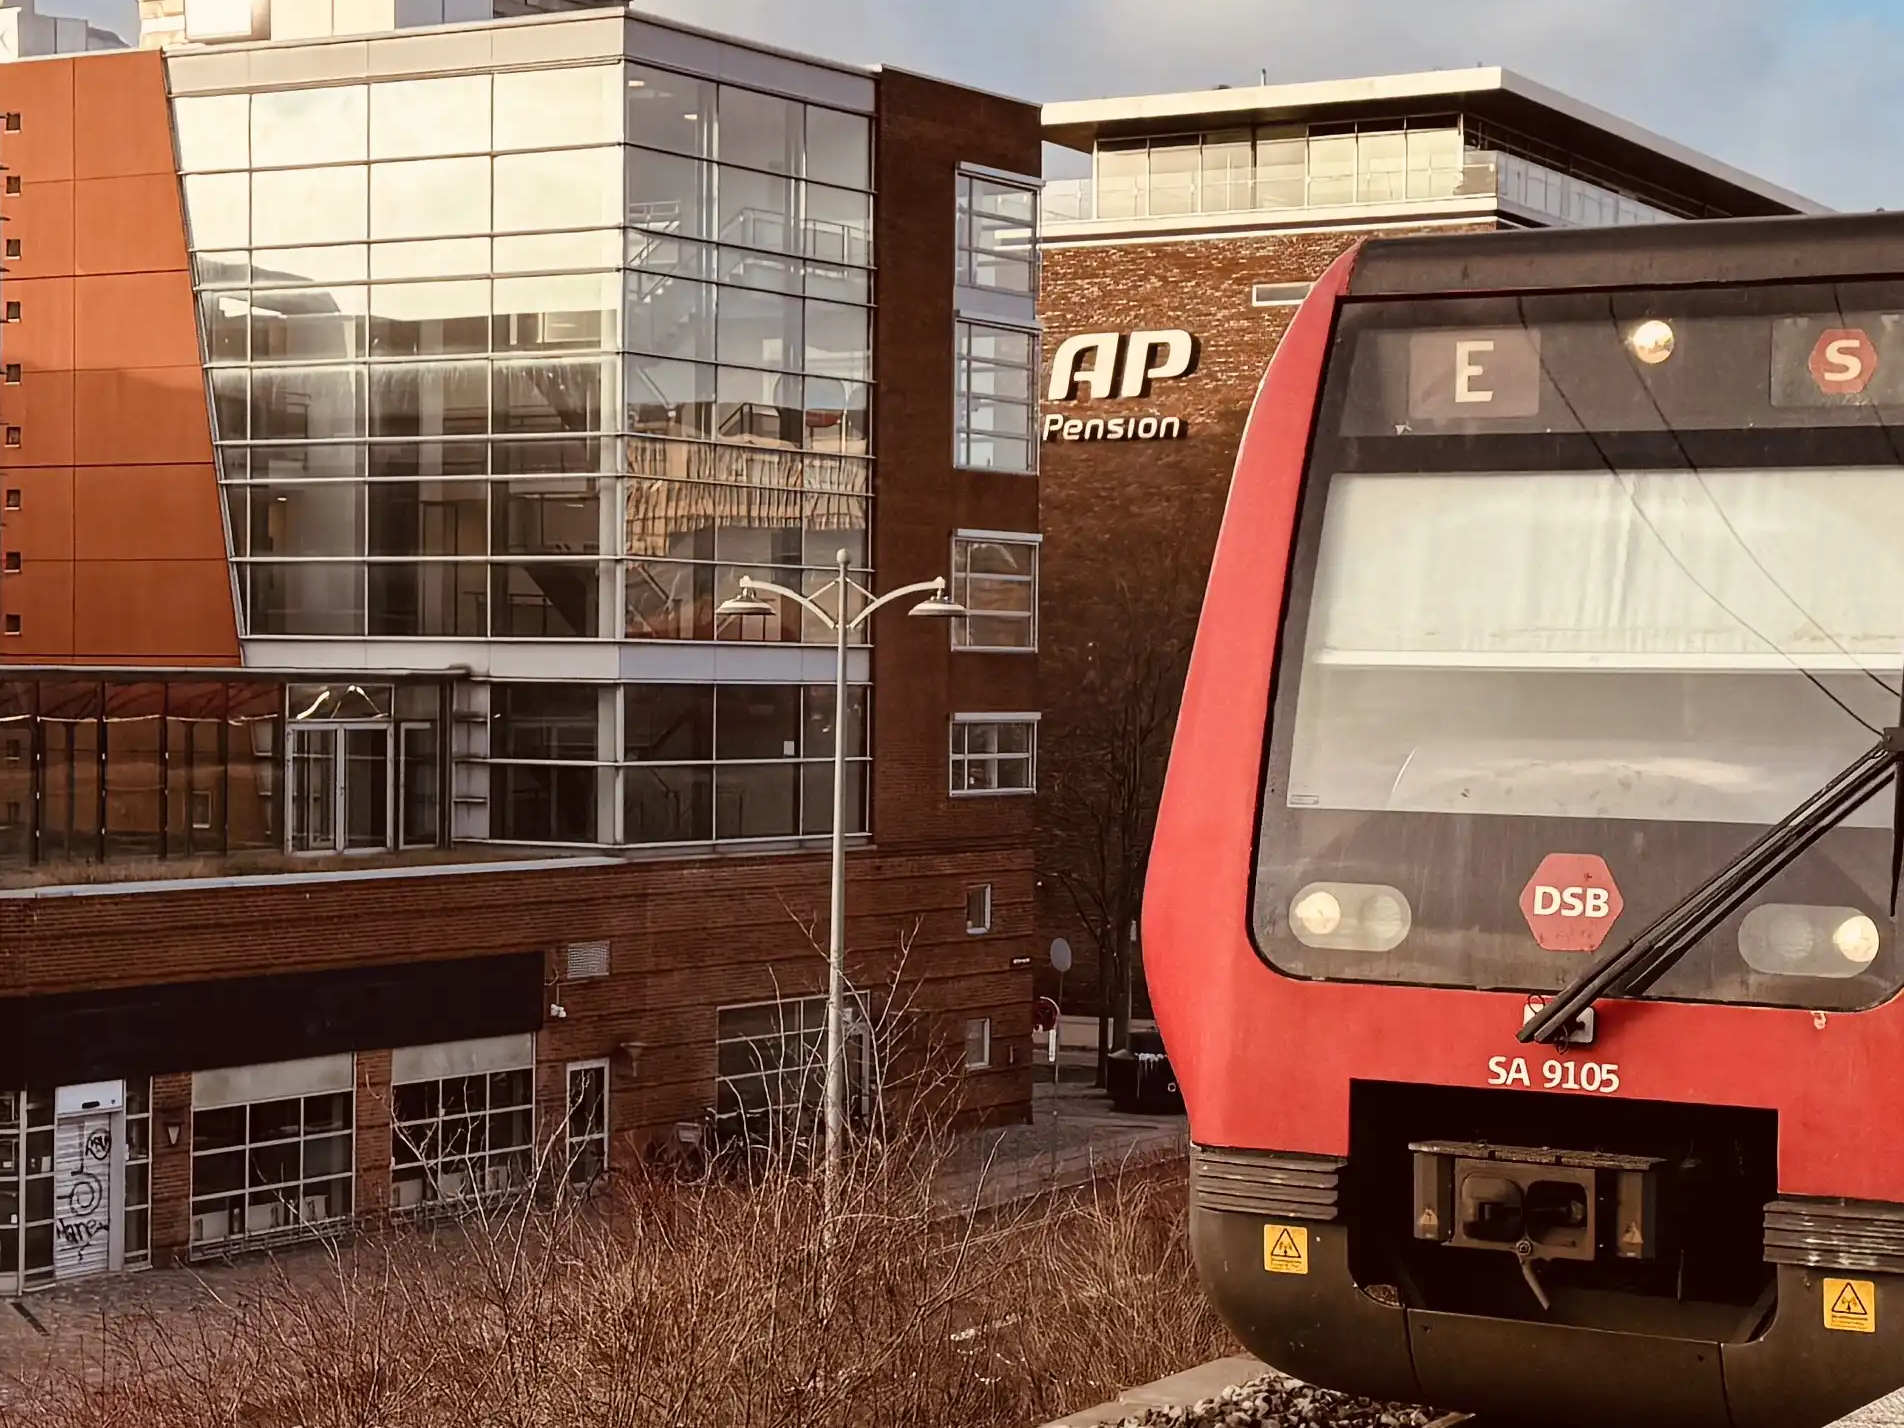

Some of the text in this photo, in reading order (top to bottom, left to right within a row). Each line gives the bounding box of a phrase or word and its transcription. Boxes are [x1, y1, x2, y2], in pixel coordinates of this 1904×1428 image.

[1047, 328, 1194, 401] AP
[1454, 340, 1495, 404] E
[1823, 338, 1864, 382] S
[1042, 413, 1181, 441] Pension
[1532, 885, 1610, 918] DSB
[1487, 1055, 1620, 1093] SA 9105
